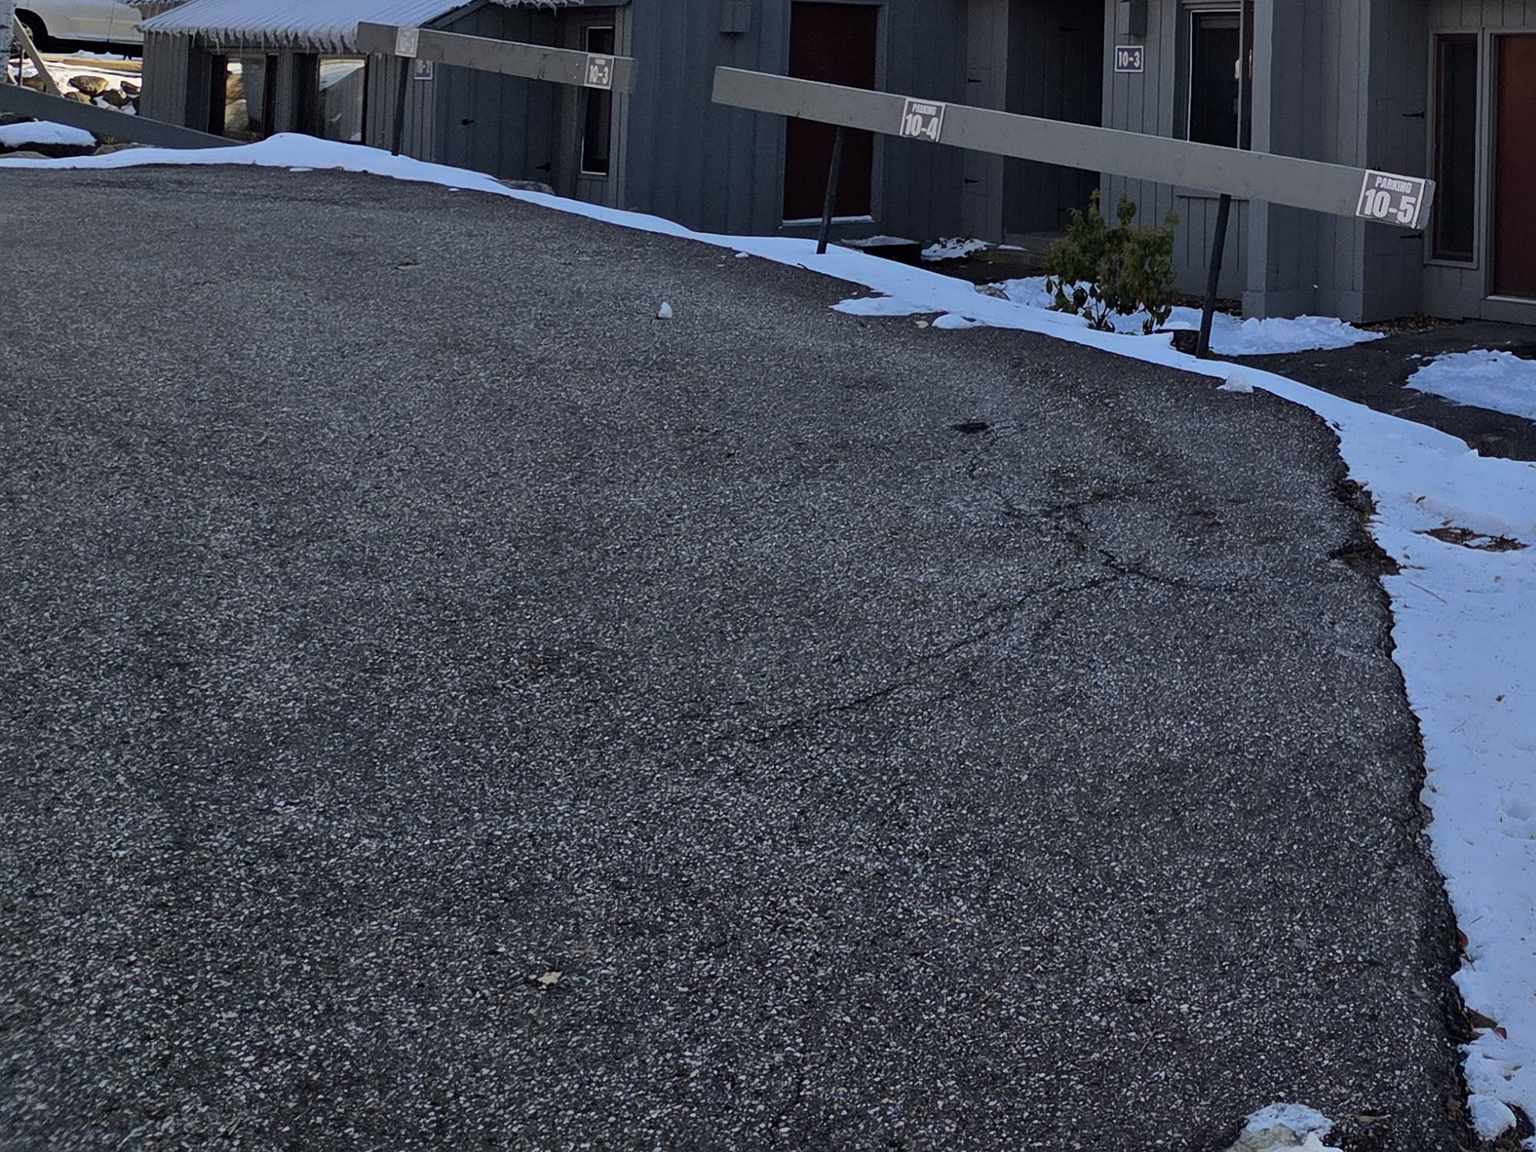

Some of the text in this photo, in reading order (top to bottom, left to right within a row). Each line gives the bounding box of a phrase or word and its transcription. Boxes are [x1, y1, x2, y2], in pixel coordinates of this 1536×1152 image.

[1119, 51, 1140, 67] 10-3
[589, 65, 609, 84] 10-3
[905, 113, 939, 140] 10-4
[1375, 176, 1412, 194] PARKING
[1364, 188, 1417, 223] 10-5
